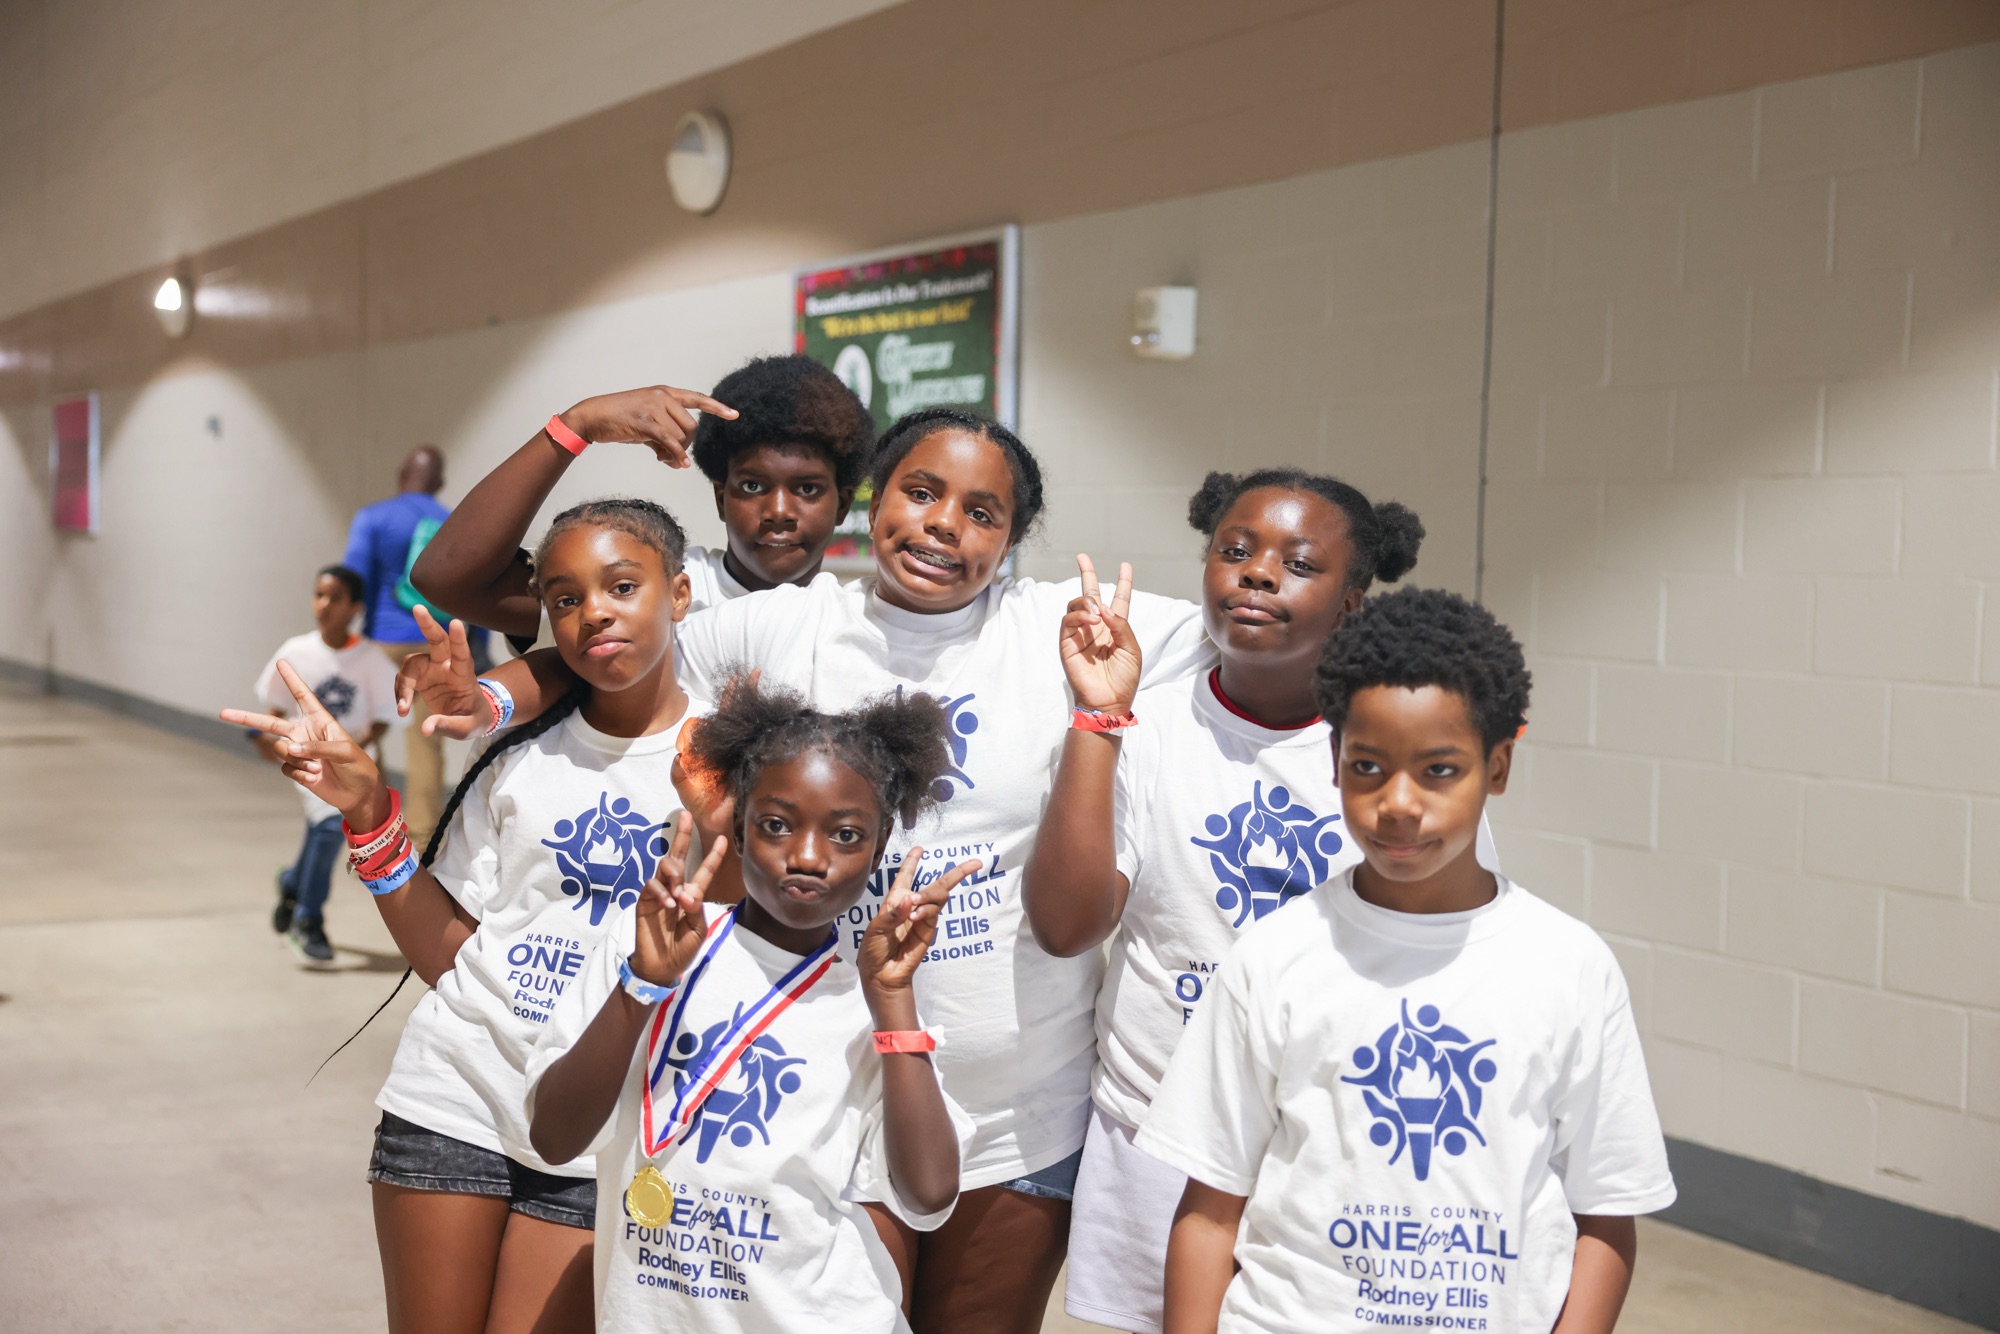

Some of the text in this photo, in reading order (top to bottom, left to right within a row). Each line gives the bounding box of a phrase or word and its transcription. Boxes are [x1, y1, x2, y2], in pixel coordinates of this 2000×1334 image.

[921, 842, 994, 860] COUNTY
[525, 933, 580, 949] HARRIS
[945, 915, 990, 939] Ellis
[507, 943, 585, 977] ONE
[702, 1188, 770, 1209] COUNTY
[709, 1206, 780, 1241] ALL
[1342, 1204, 1504, 1223] HARRIS COUNTY
[626, 1222, 764, 1264] FOUNDATION
[1328, 1218, 1422, 1251] ONE
[1443, 1223, 1518, 1259] ALL
[638, 1247, 747, 1286] Rodney Ellis
[1342, 1255, 1506, 1285] FOUNDATION
[637, 1273, 750, 1301] COMMISSIONER
[1358, 1279, 1489, 1311] Rodney Ellis
[1355, 1307, 1488, 1330] COMMISSIONER
